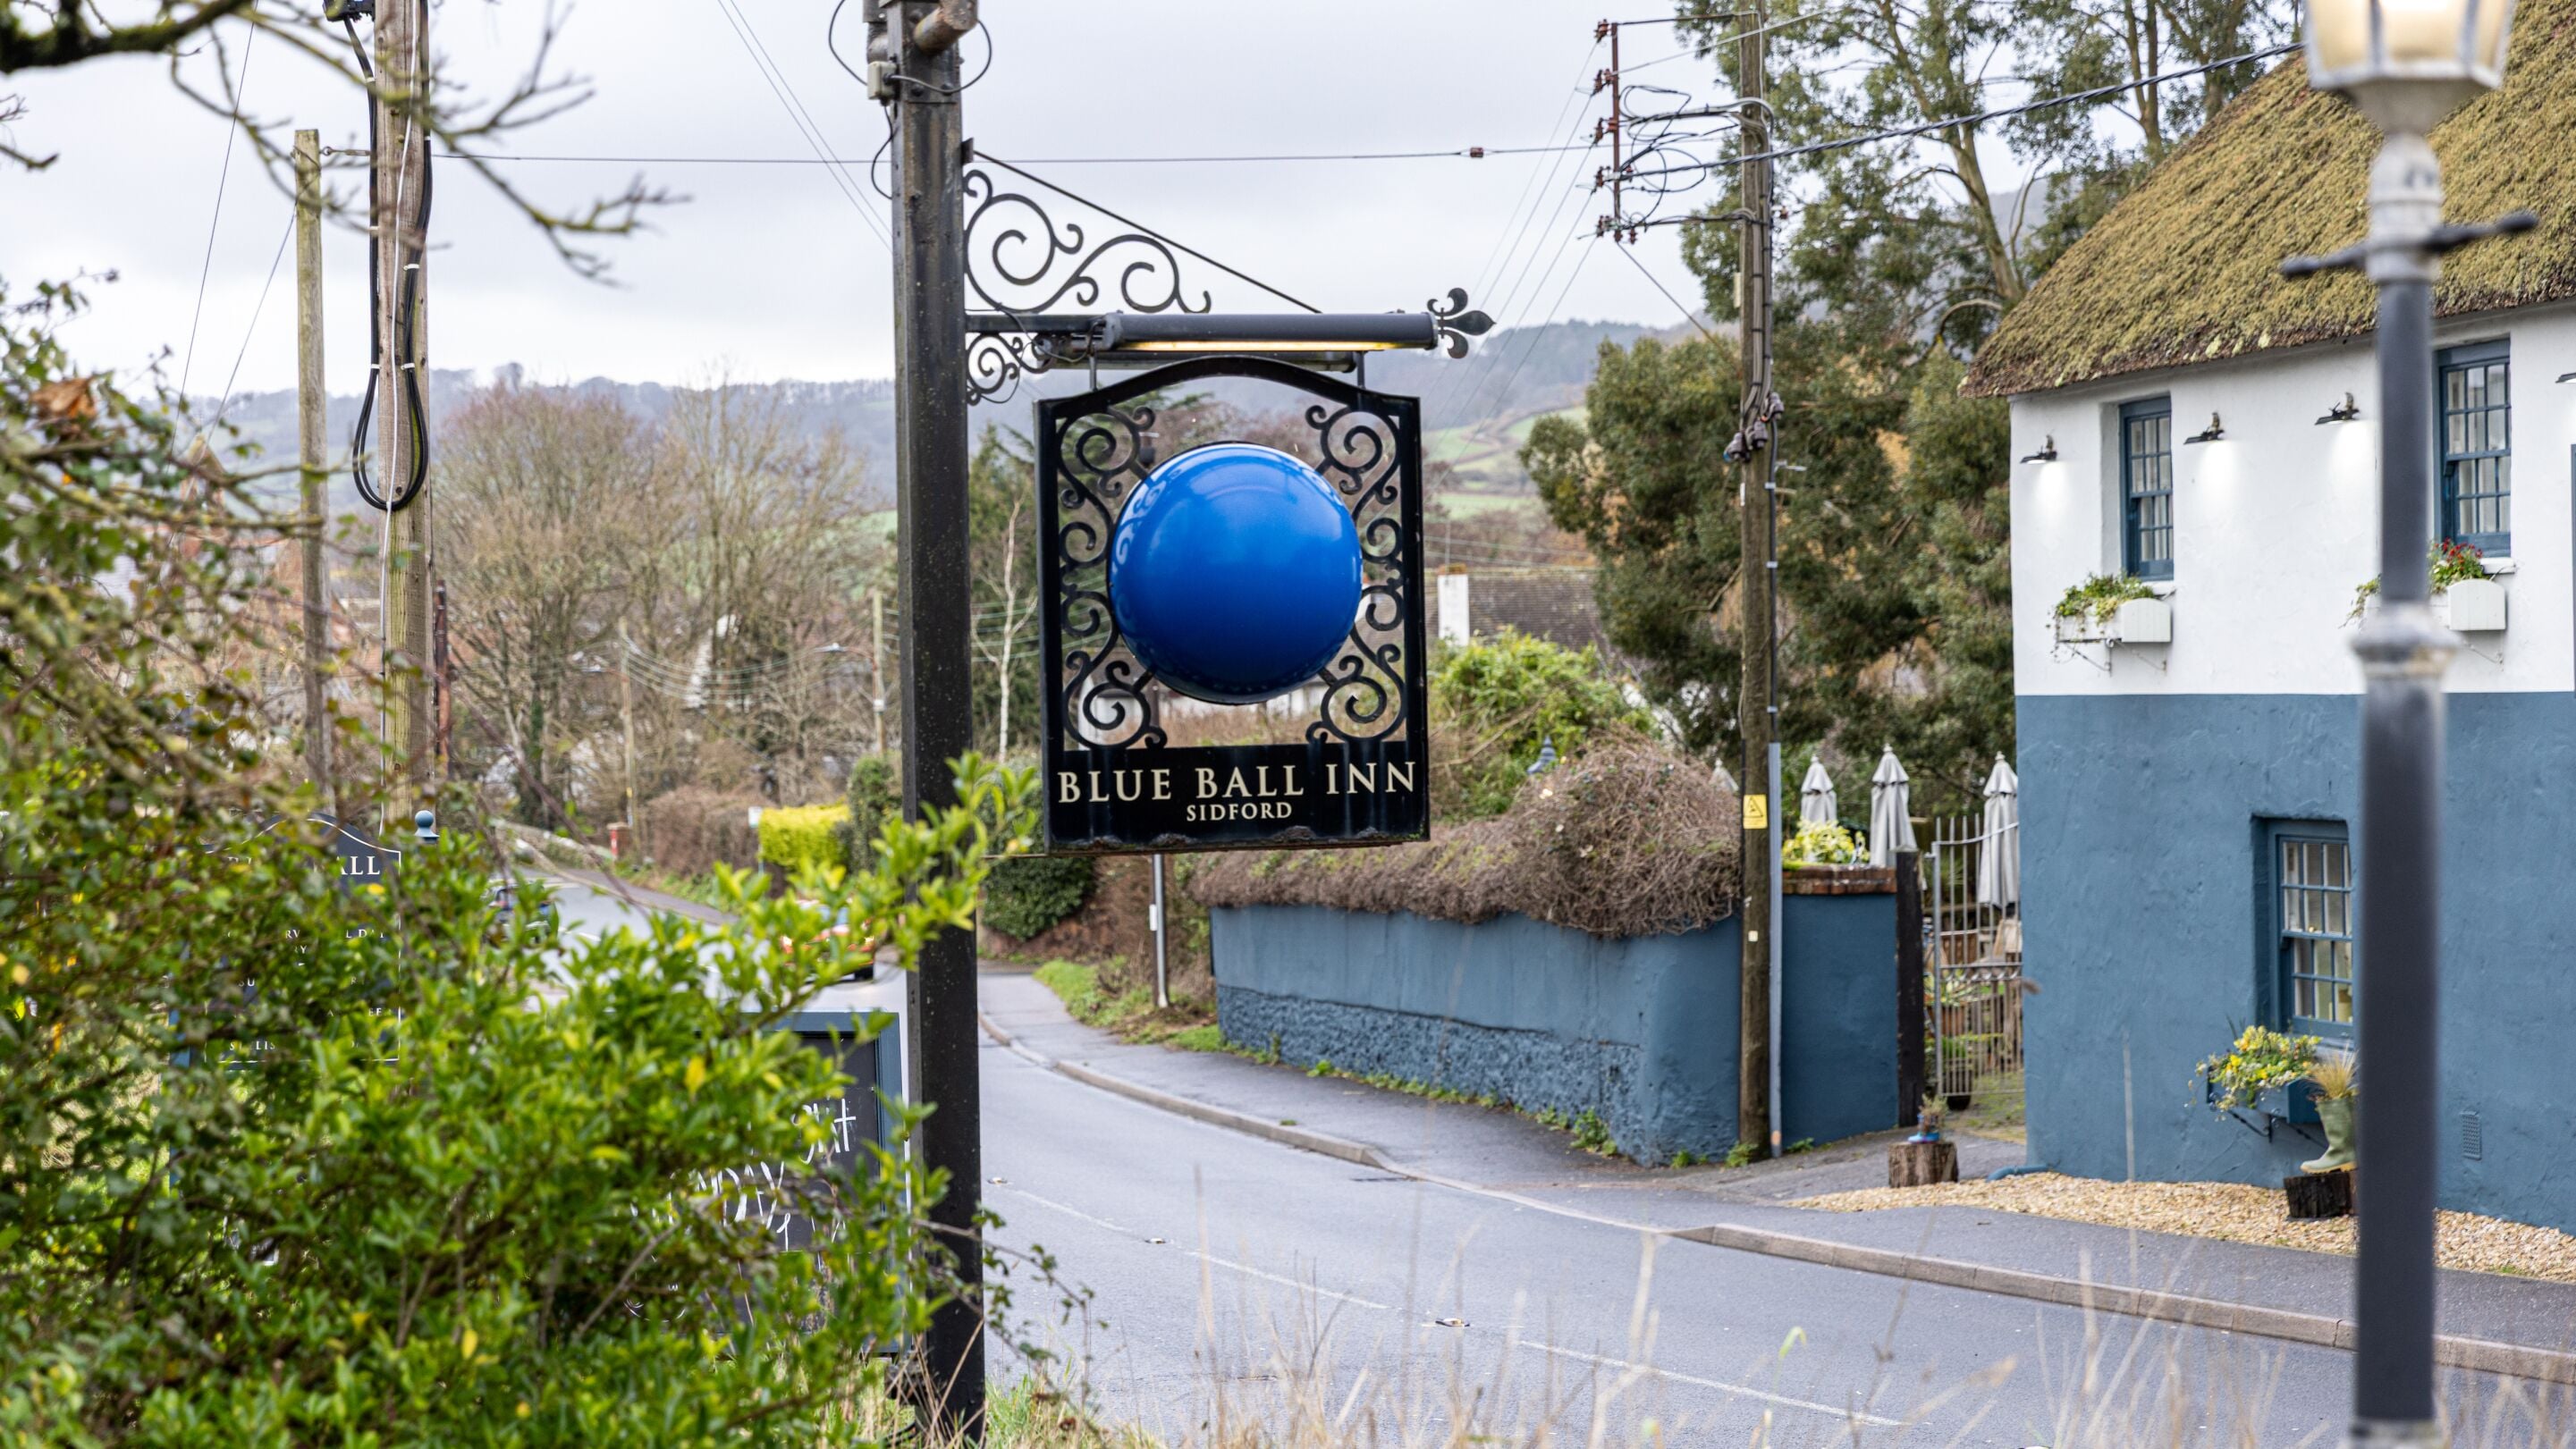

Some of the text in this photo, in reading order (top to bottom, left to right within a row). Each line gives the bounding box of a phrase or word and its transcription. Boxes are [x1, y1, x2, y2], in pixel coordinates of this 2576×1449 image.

[1058, 760, 1416, 804] BLUE BALL INN
[1186, 801, 1293, 822] SIDFORD
